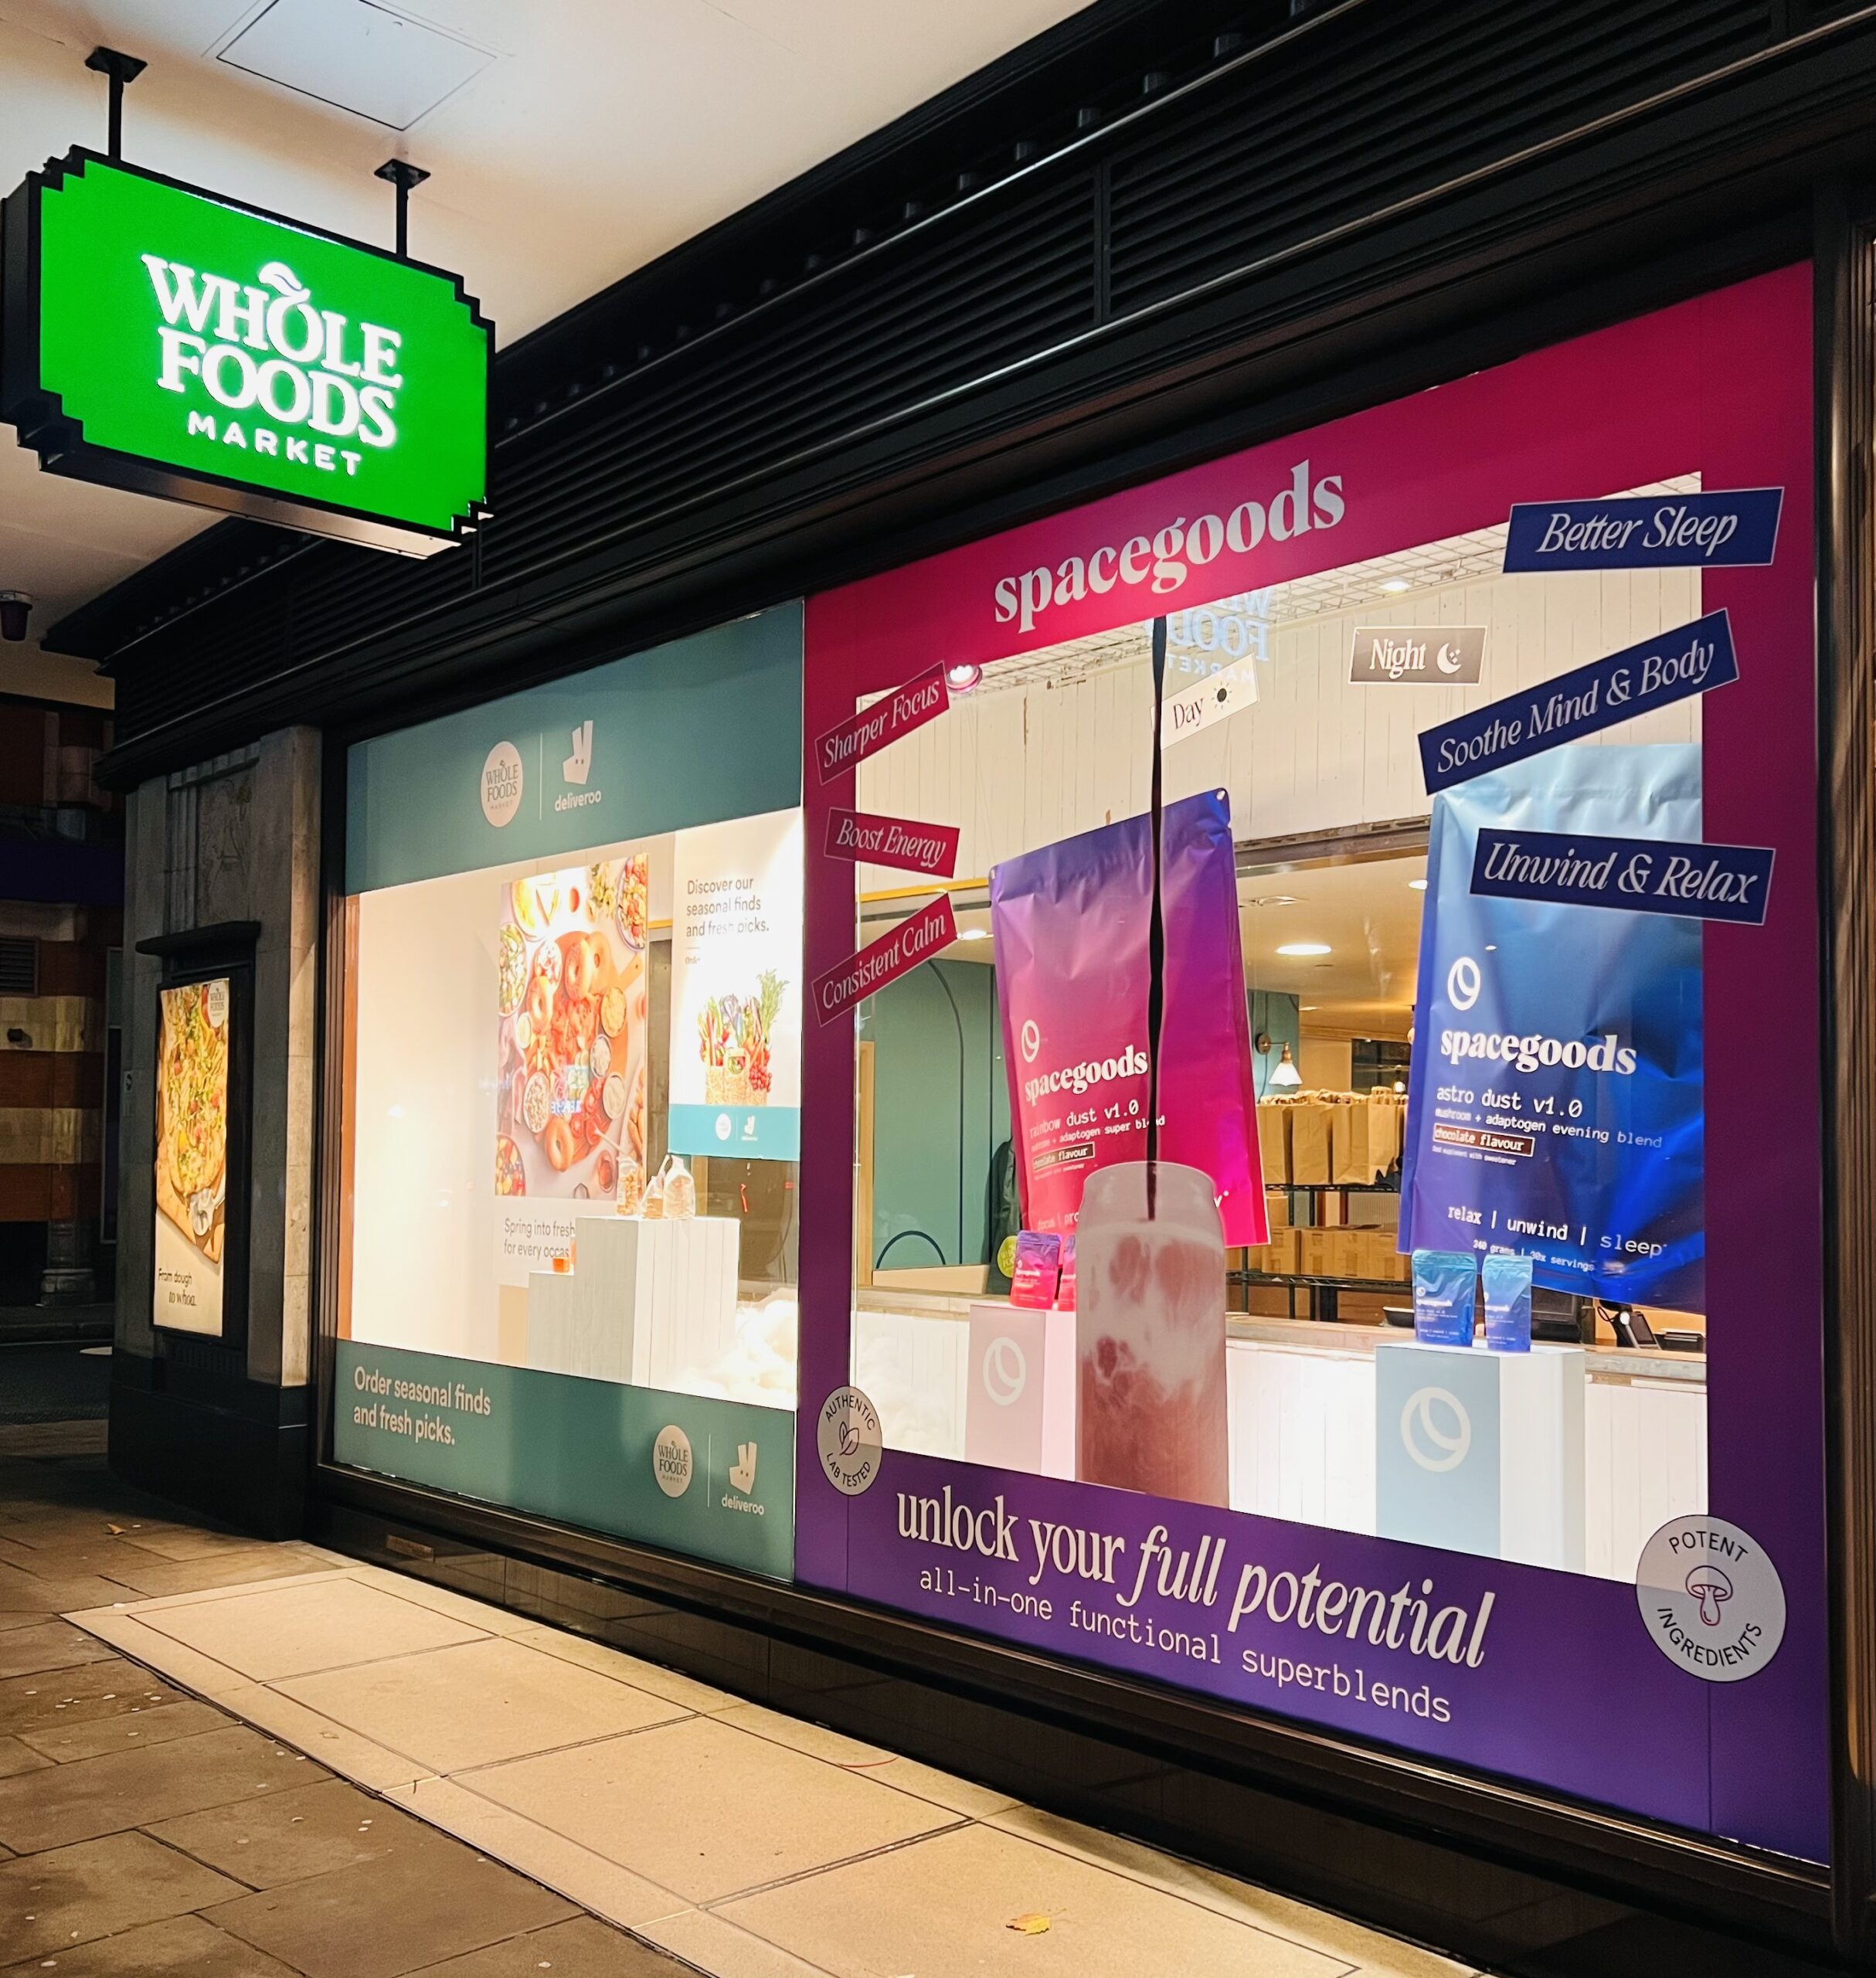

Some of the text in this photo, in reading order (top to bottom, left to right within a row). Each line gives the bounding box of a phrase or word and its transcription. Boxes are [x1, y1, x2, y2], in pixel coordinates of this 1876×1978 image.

[141, 254, 403, 389] WHOLE
[157, 326, 397, 448] FOODS
[187, 410, 362, 476] MARKET
[994, 460, 1345, 634] spacegoods
[1535, 506, 1738, 556] Better Sleep
[1369, 638, 1426, 680] Night
[1173, 698, 1204, 729] Day
[1436, 639, 1715, 773] Soothe Mind & Body
[824, 681, 940, 768] Sharper Focus
[486, 763, 518, 786] WHOLE
[487, 780, 518, 802] FOODS
[554, 790, 602, 812] deliveroo
[835, 818, 946, 868] Boost Energy
[687, 878, 754, 895] Discover our
[1483, 843, 1759, 904] Unwind & Relax
[686, 895, 761, 916] seasonal finds
[686, 920, 706, 938] and
[737, 916, 770, 934] picks.
[822, 914, 946, 1009] Consistent Calm
[1441, 1029, 1637, 1075] spacegoods
[1025, 1044, 1148, 1106] spacegoods
[1436, 1085, 1583, 1118] astro dust v1.0
[1029, 1099, 1140, 1140] rainbow dust v1.0
[1059, 1127, 1101, 1144] adaptogen
[1104, 1123, 1131, 1135] super
[1486, 1114, 1546, 1133] adaptogen
[1552, 1123, 1609, 1144] evening
[1617, 1130, 1662, 1148] blend
[1058, 1147, 1088, 1161] flavour
[1435, 1127, 1524, 1151] chocolate flavour
[505, 1218, 576, 1238] Spring into fresh
[1448, 1206, 1482, 1225] relax
[1507, 1217, 1568, 1241] unwind
[503, 1239, 569, 1261] for every occas
[1490, 1245, 1515, 1257] grams
[1550, 1255, 1596, 1272] servings
[174, 1269, 192, 1288] dough
[354, 1366, 491, 1416] Order seasonal finds
[353, 1403, 456, 1446] and fresh picks.
[825, 1394, 875, 1431] AUTHENTIC
[658, 1444, 689, 1463] WHOLE
[658, 1459, 688, 1477] FOODS
[827, 1453, 871, 1487] LAB TESTED
[721, 1493, 765, 1516] deliveroo
[1668, 1531, 1749, 1562] POTENT
[896, 1485, 1496, 1669] unlock your full potential
[919, 1566, 1452, 1724] all-in-one functional superblends
[1657, 1608, 1762, 1667] INGREDIENTS
